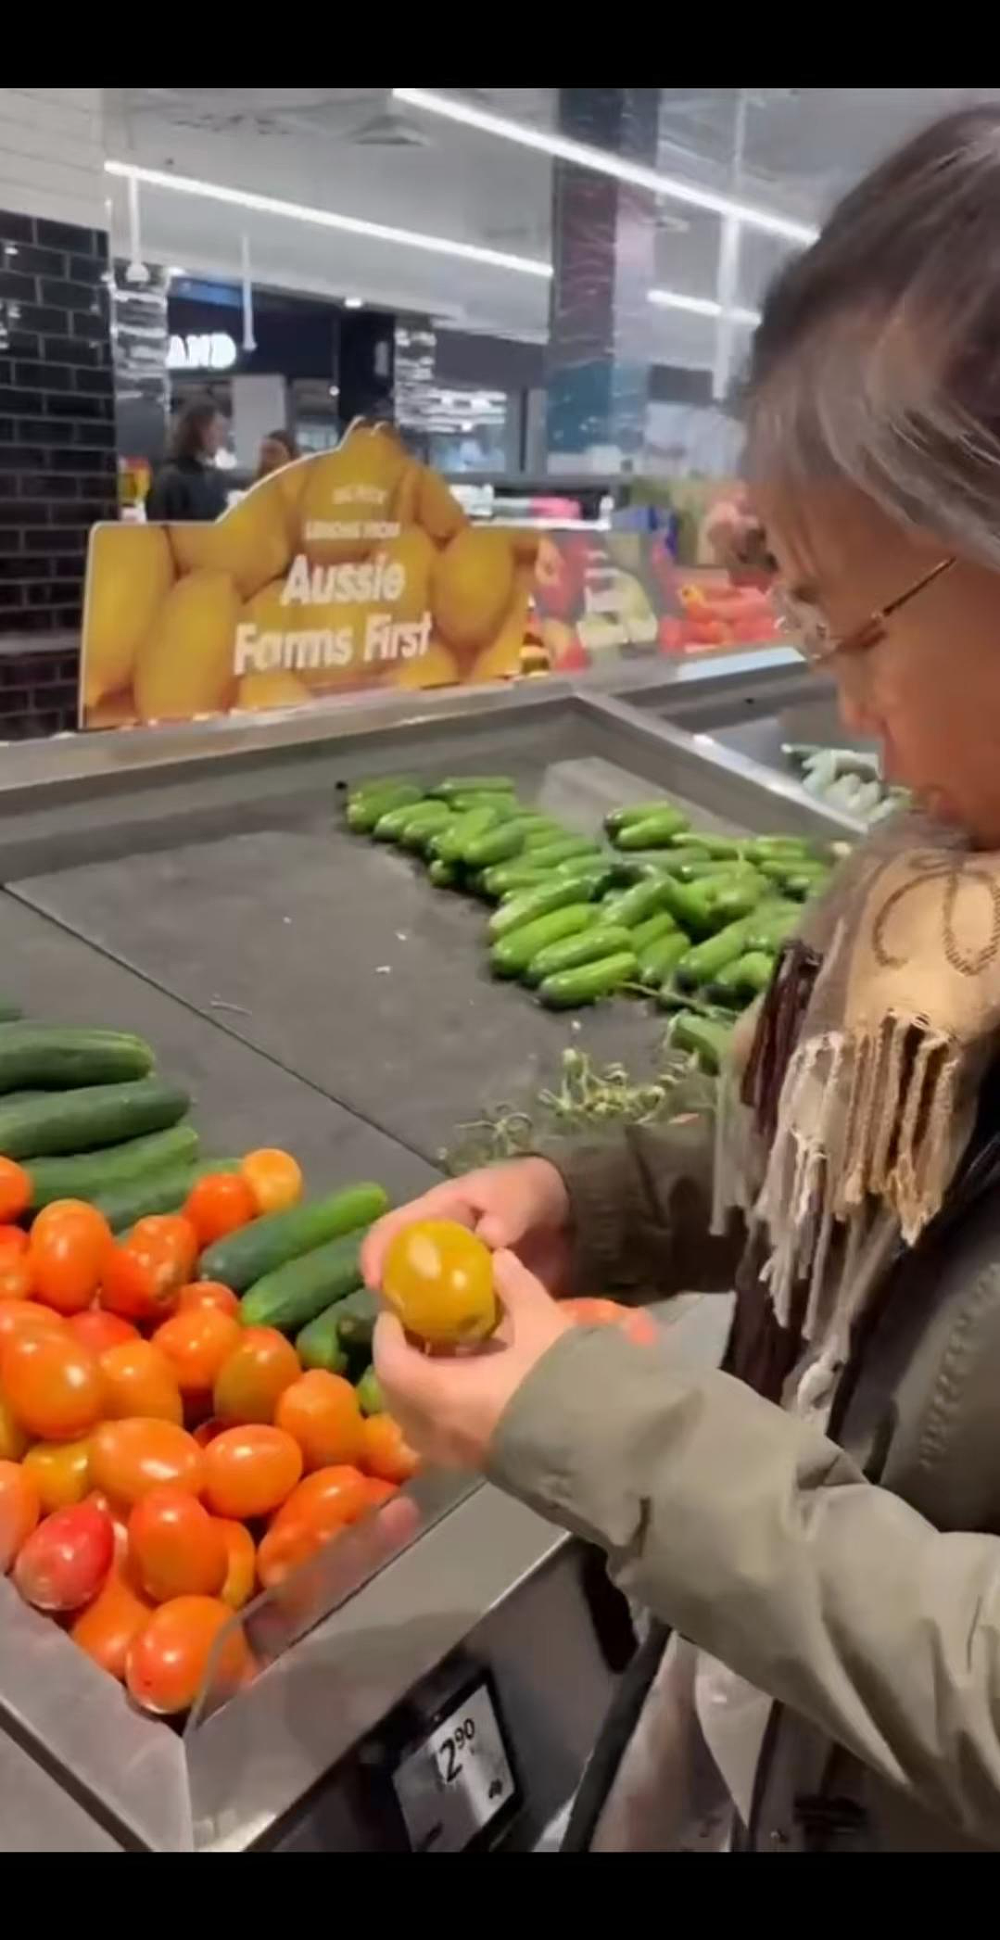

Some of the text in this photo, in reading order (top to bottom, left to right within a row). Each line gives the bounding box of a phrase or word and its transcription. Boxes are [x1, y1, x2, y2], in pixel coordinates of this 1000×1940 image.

[280, 554, 405, 605] Aussie
[234, 611, 432, 675] Farms First
